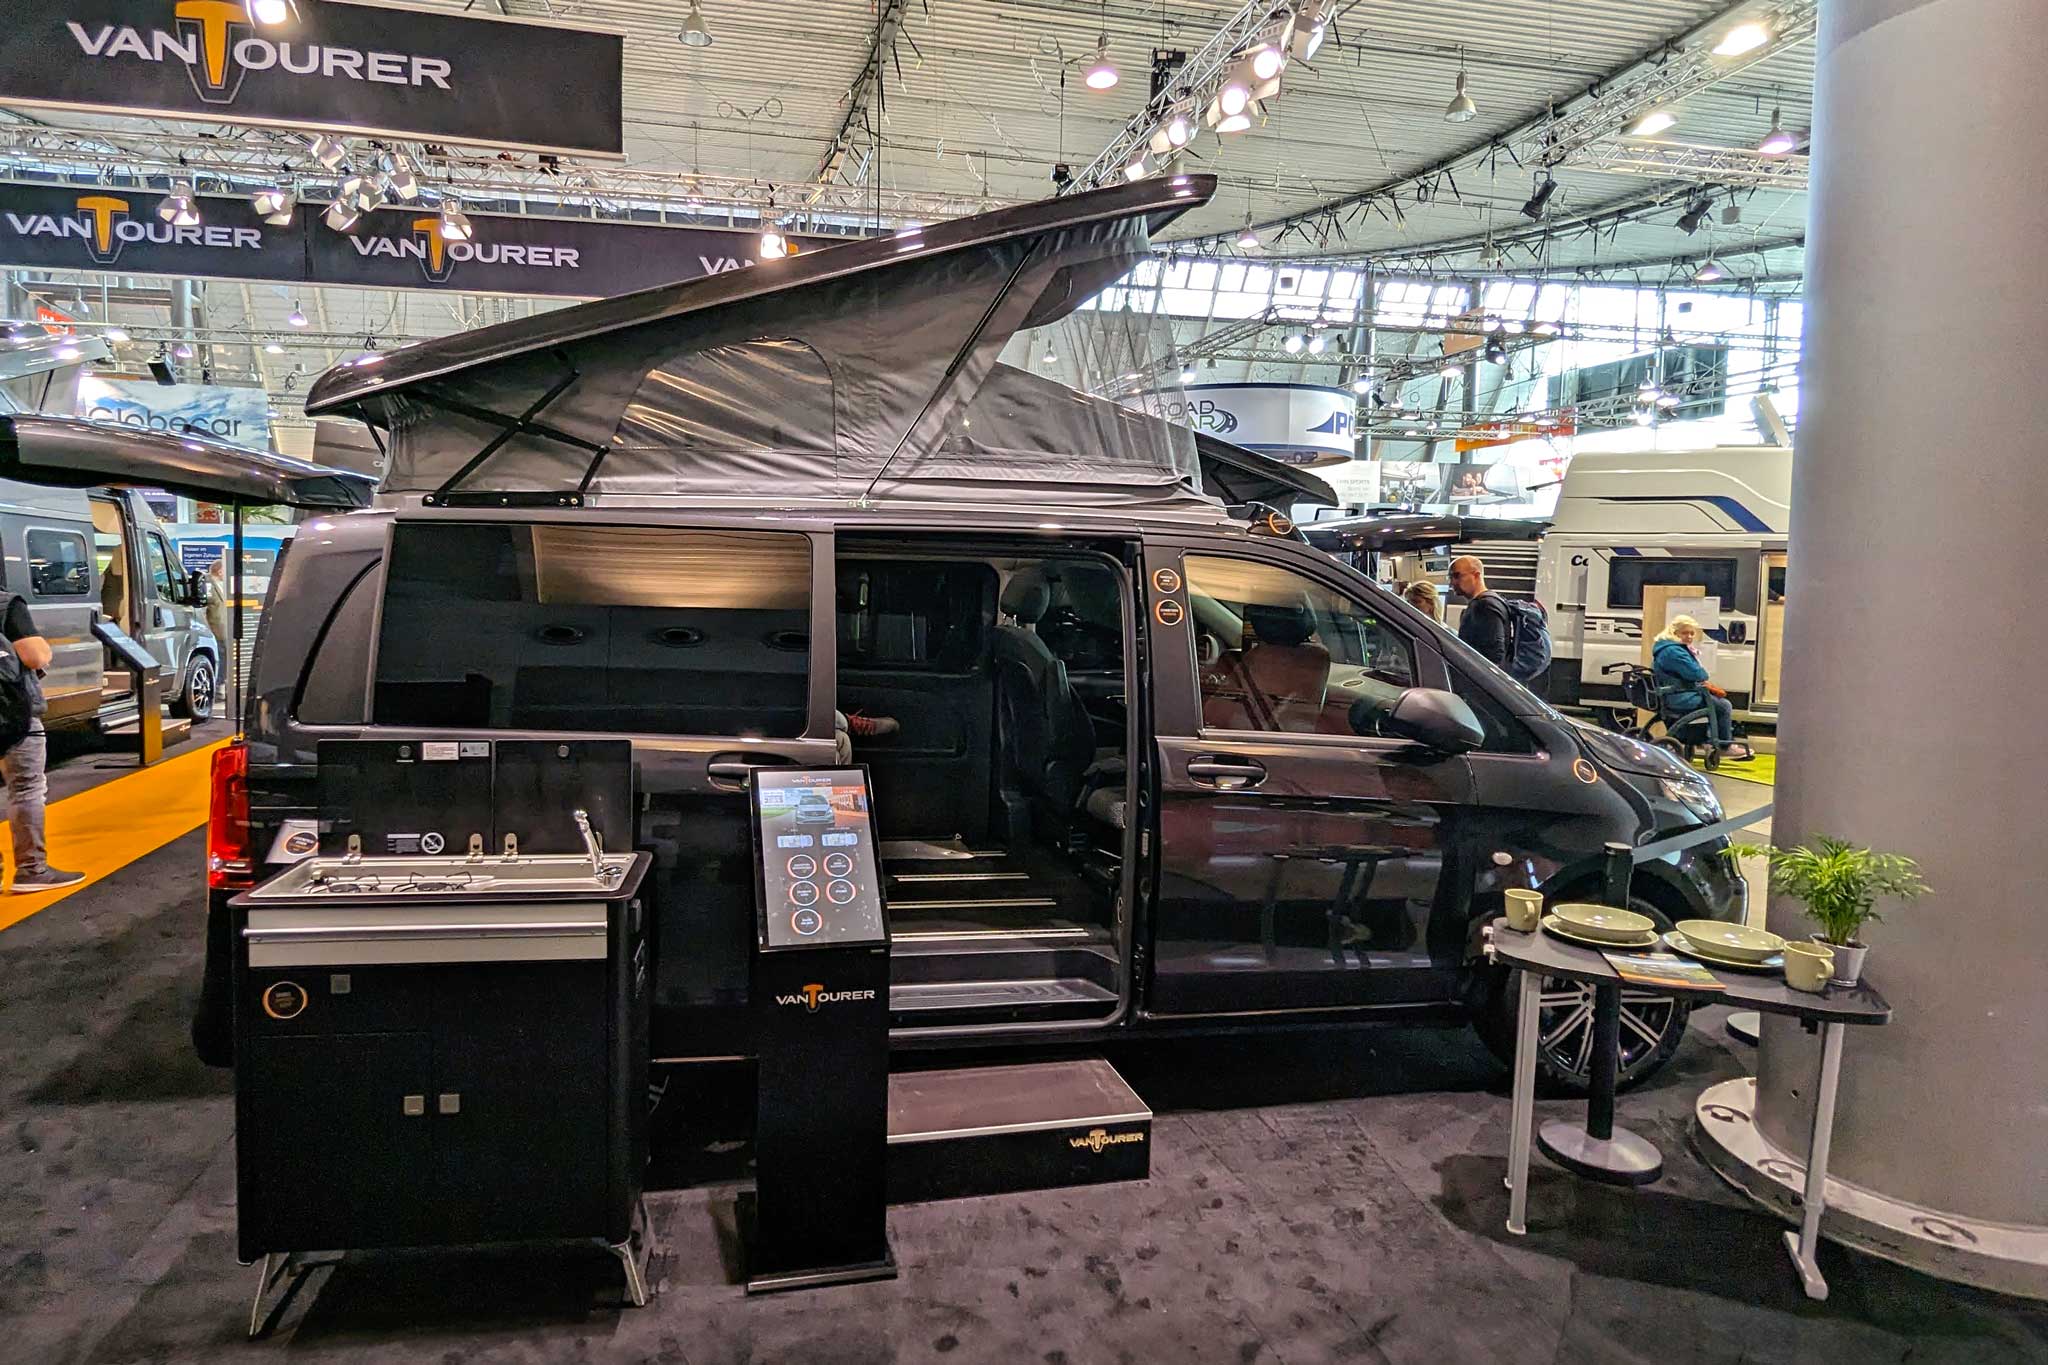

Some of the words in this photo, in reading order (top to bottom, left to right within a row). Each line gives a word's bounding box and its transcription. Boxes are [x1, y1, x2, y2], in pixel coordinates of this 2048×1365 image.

[66, 1, 452, 91] VANTOURER
[6, 196, 263, 251] VANTOURER
[350, 218, 580, 272] VANTOURER
[775, 984, 876, 1010] VANTOURER
[1069, 1128, 1145, 1150] VANTOURER
